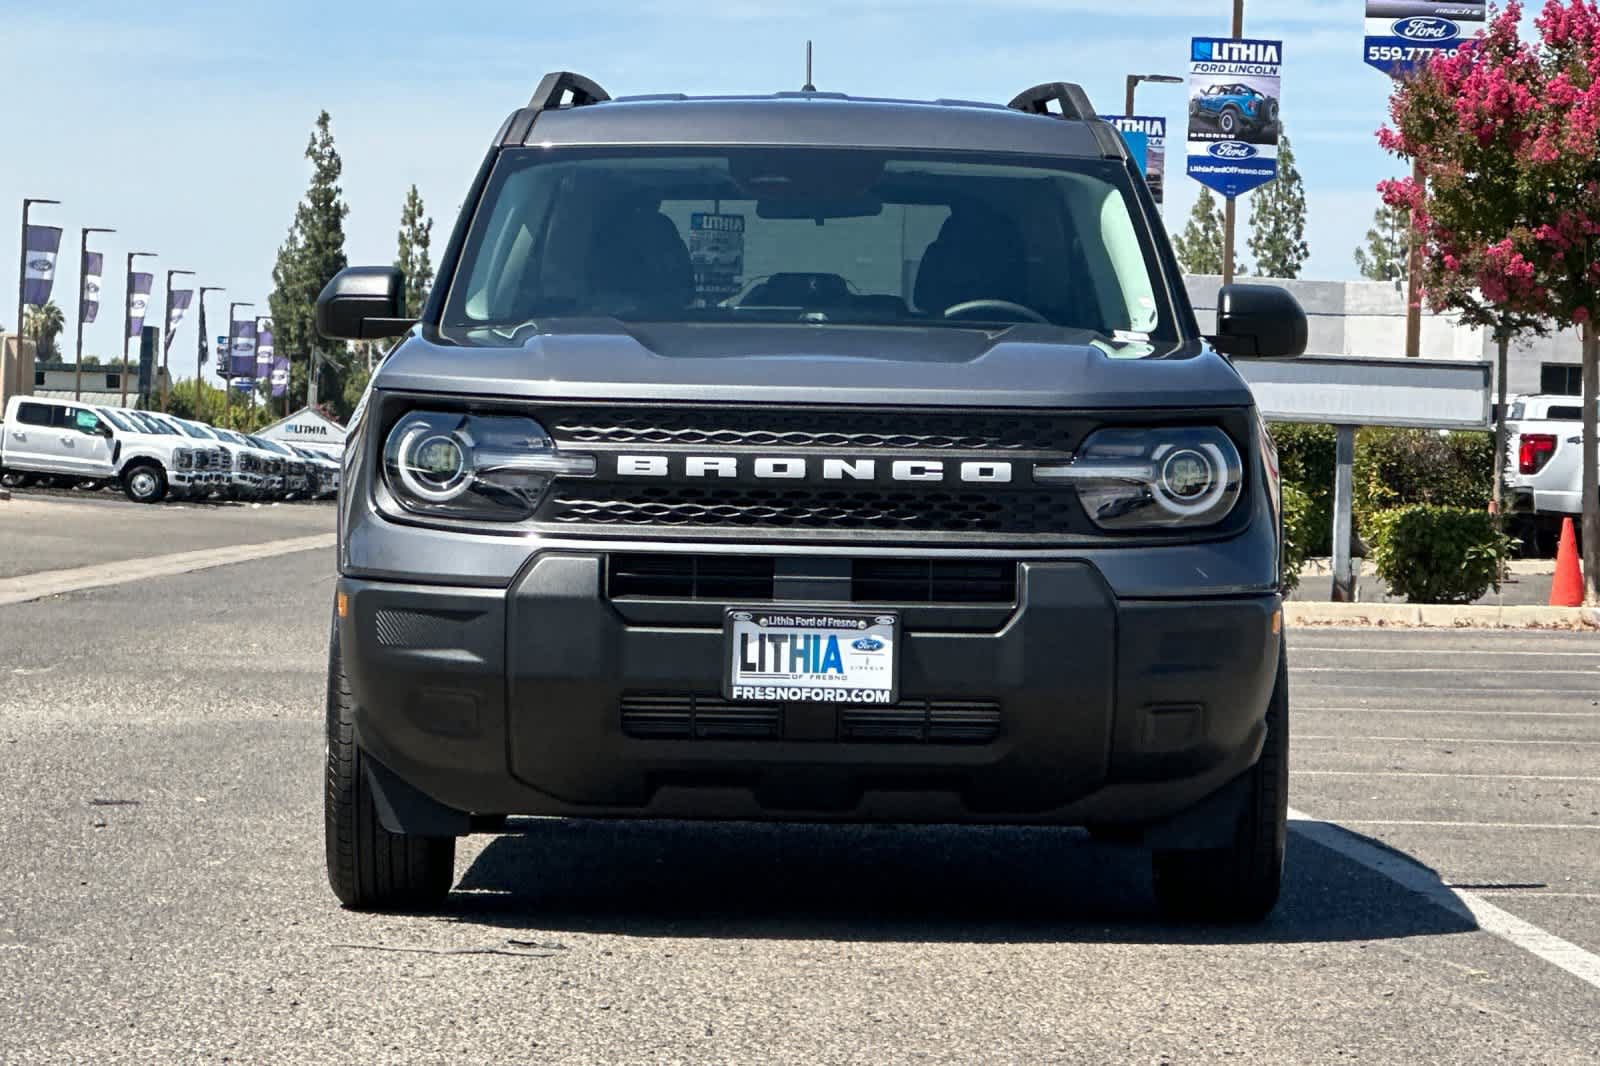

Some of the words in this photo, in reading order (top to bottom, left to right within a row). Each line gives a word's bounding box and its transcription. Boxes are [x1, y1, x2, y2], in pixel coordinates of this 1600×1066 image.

[1404, 19, 1447, 38] Ford
[1211, 42, 1279, 62] LITHIA
[1193, 63, 1226, 73] FORD
[1228, 64, 1278, 74] LINCOLN
[1217, 142, 1249, 157] Ford
[294, 424, 328, 436] LITHIA
[616, 454, 1012, 483] BRONCO
[768, 615, 795, 626] Lithia
[795, 617, 816, 626] Ford
[817, 617, 827, 627] of
[828, 617, 858, 628] Fresno
[740, 633, 844, 674] LITHIA
[732, 686, 891, 703] FRESNOFORD.COM
